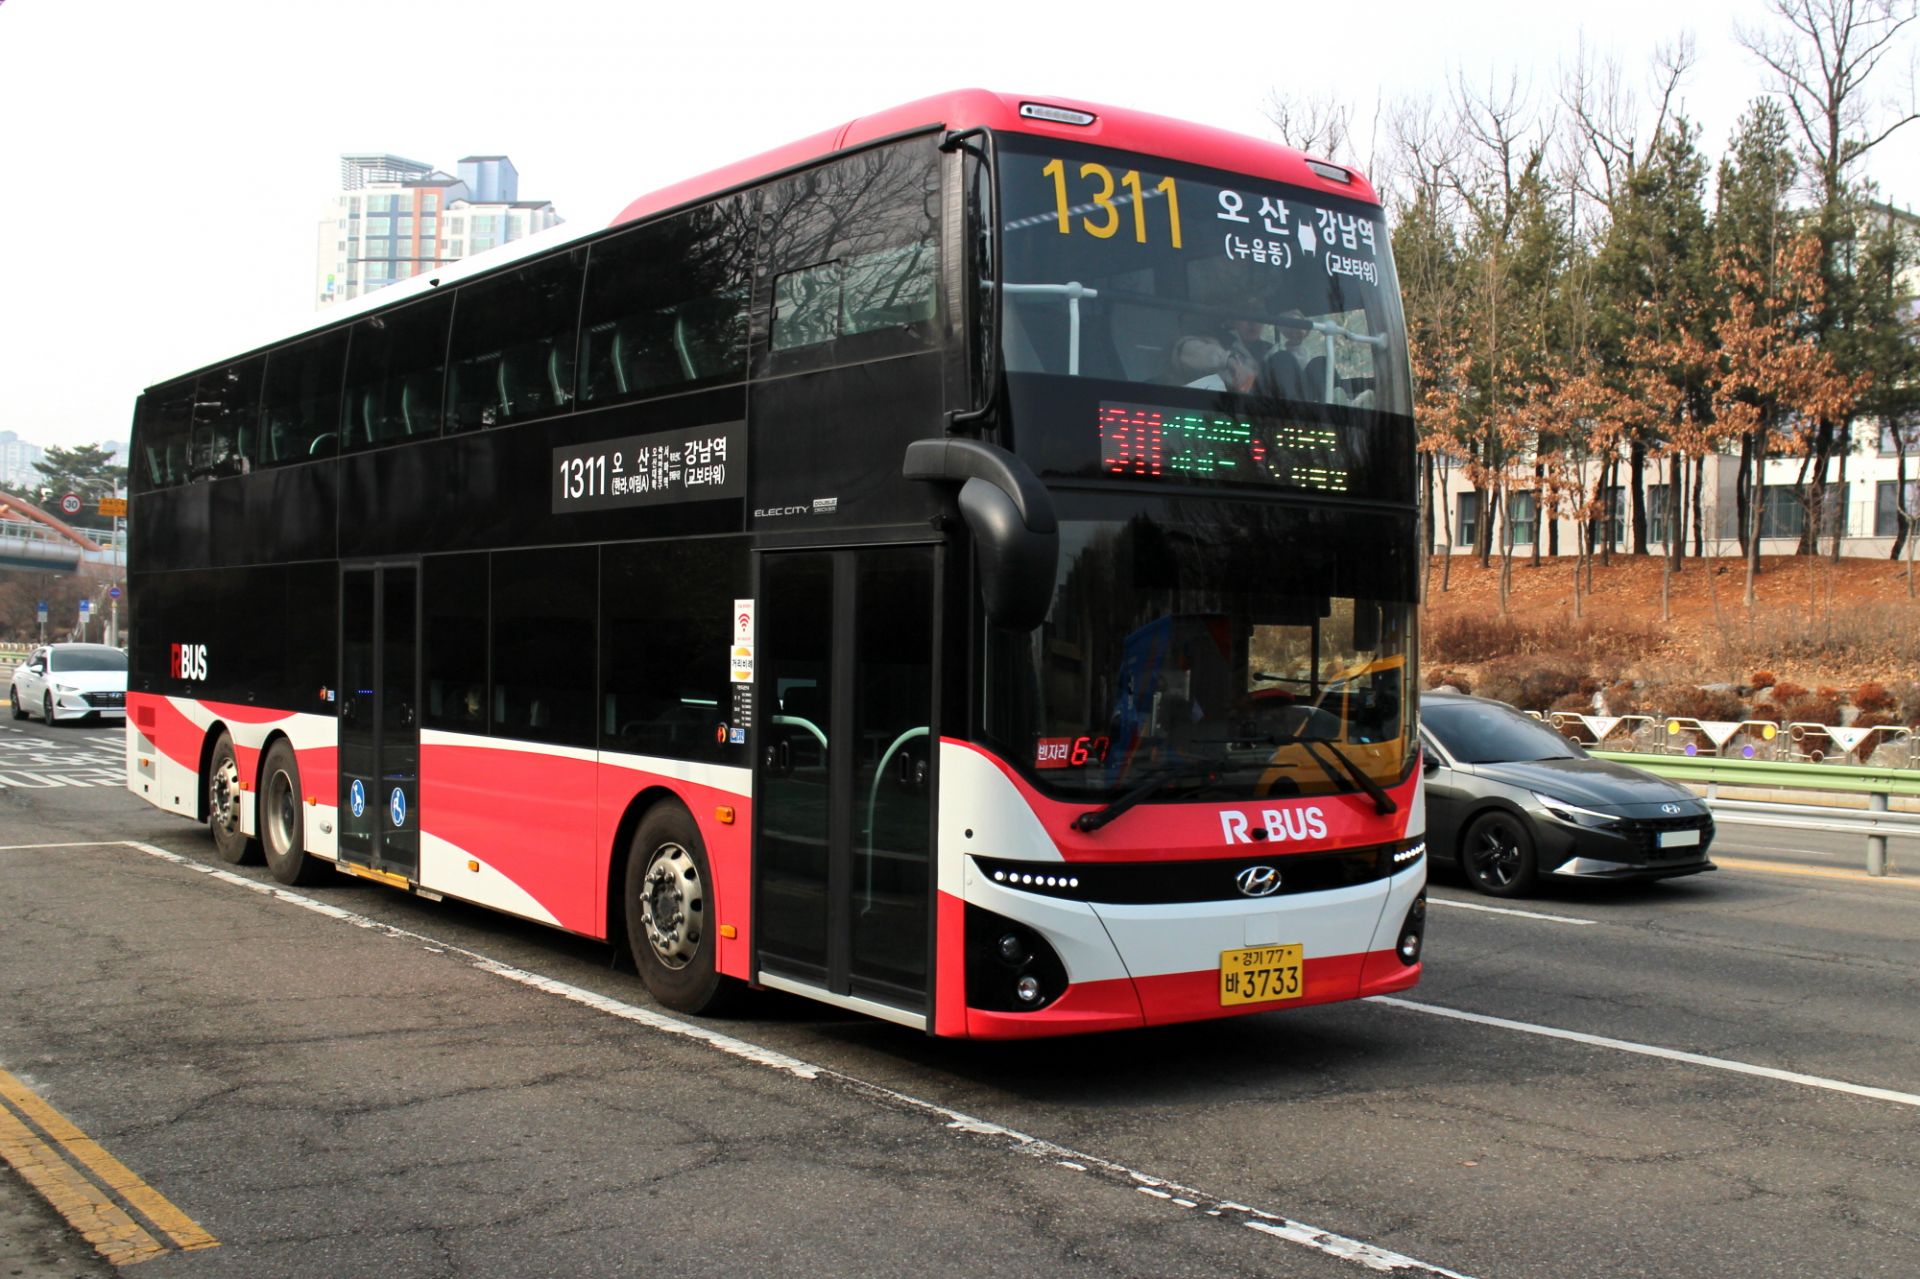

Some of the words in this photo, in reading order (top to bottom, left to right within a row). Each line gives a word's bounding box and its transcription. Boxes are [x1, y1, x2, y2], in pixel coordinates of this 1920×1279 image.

[1042, 158, 1182, 249] 1311
[1315, 207, 1376, 256] 강남역
[1225, 233, 1291, 268] (누읍동)
[1325, 251, 1378, 286] (교보타워)
[684, 436, 727, 465] 강남역
[560, 455, 605, 499] 1311
[684, 463, 726, 488] (교보타워)
[65, 499, 78, 509] 30
[754, 507, 783, 517] ELEC
[784, 505, 811, 515] CITY
[731, 658, 753, 669] 거리비례
[1038, 743, 1069, 761] 빈자리
[1219, 809, 1253, 844] R
[1262, 806, 1327, 843] BUS
